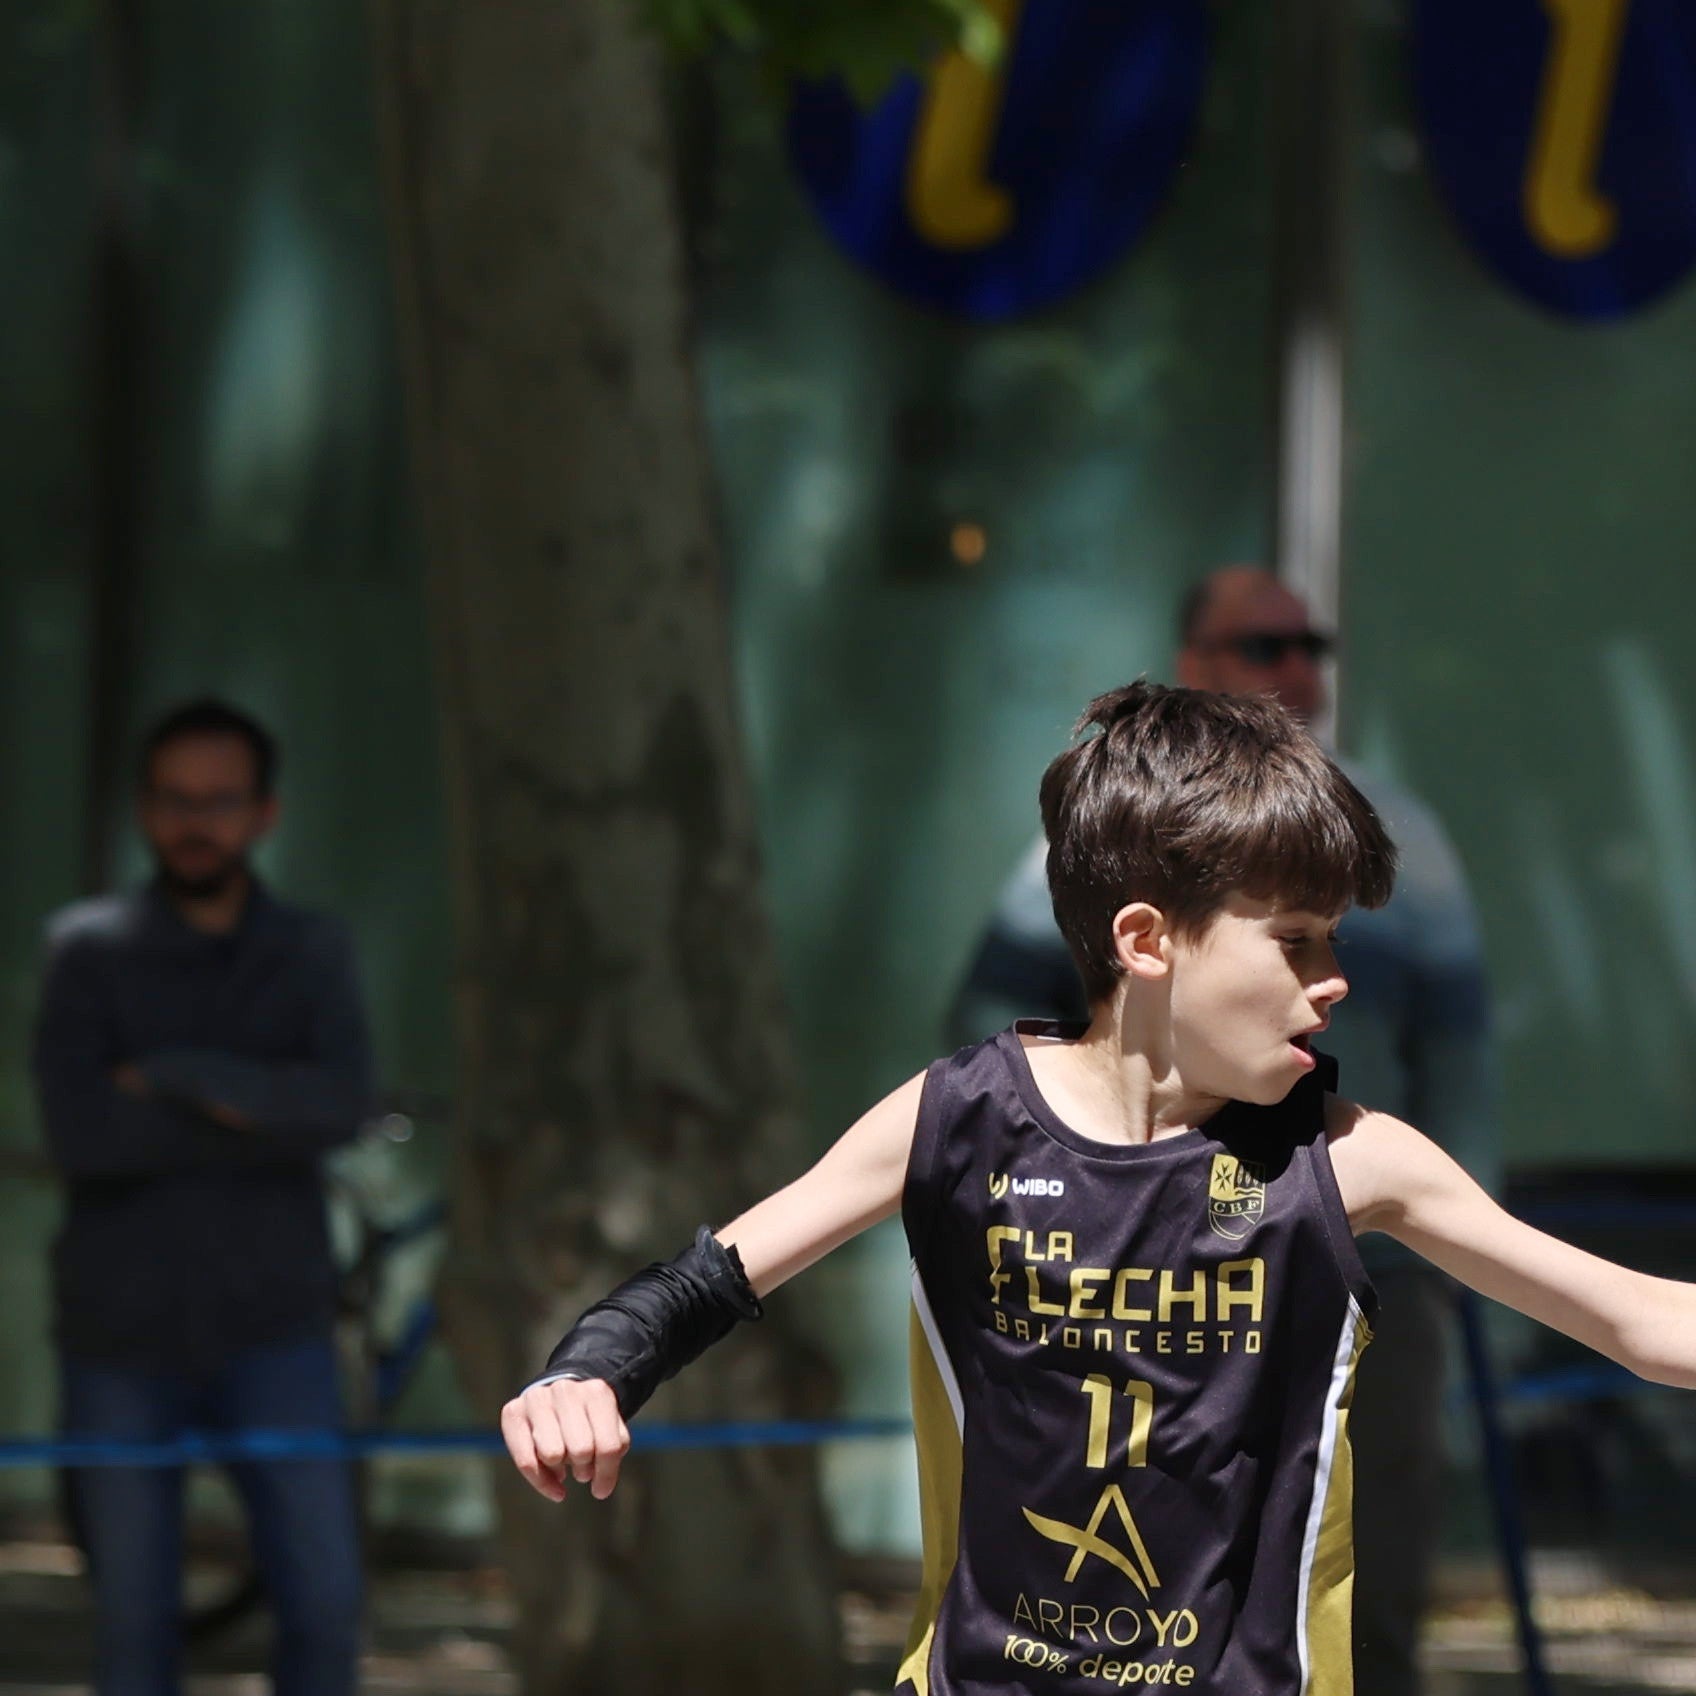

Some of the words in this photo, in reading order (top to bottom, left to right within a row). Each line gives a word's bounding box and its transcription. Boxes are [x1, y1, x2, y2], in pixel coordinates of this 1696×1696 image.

[1012, 1177, 1064, 1198] WIBO
[1023, 1230, 1073, 1263] LA
[986, 1226, 1265, 1323] FLECHA
[995, 1313, 1261, 1355] BALONCESTO
[1080, 1372, 1154, 1469] 11
[1013, 1592, 1199, 1648] ARROYO
[1003, 1634, 1067, 1675] 100%
